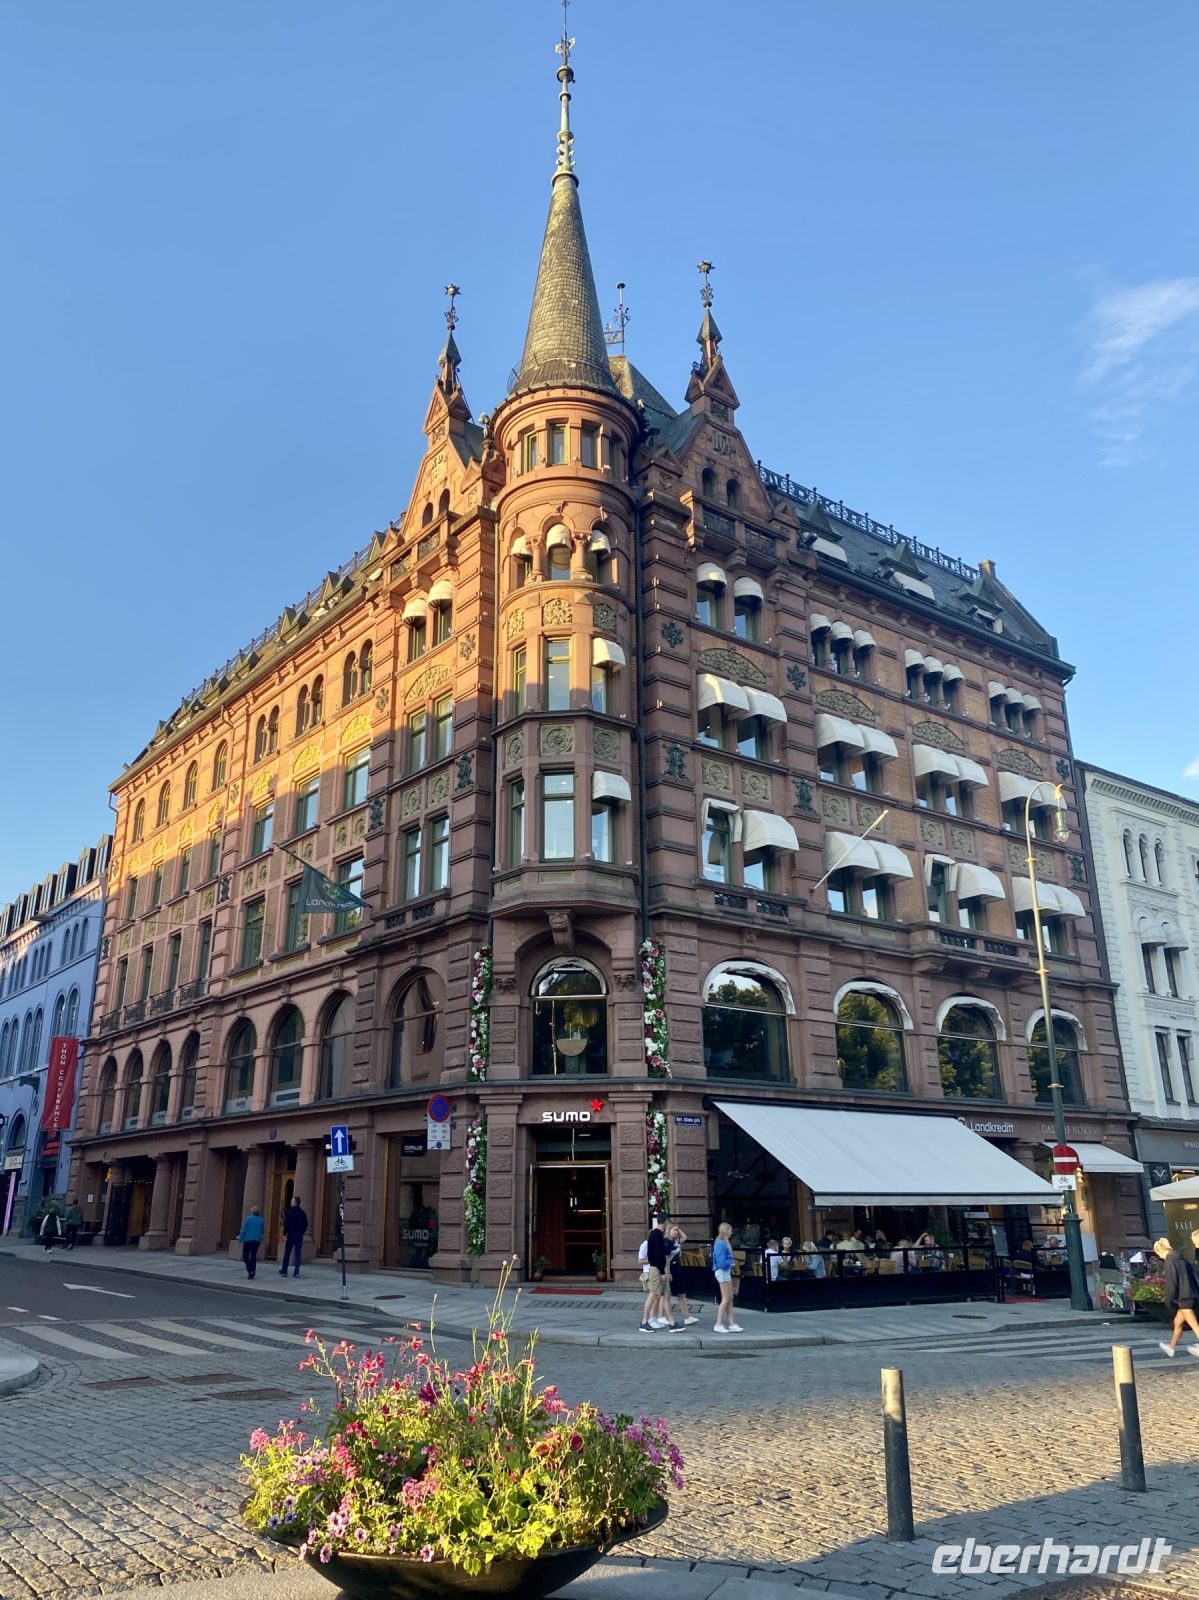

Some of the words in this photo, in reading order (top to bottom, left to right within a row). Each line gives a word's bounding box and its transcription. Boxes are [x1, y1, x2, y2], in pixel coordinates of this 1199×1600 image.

[54, 1069, 64, 1128] CONFERENCE
[970, 1121, 1014, 1133] Landkreditt
[1041, 1125, 1057, 1134] DAL
